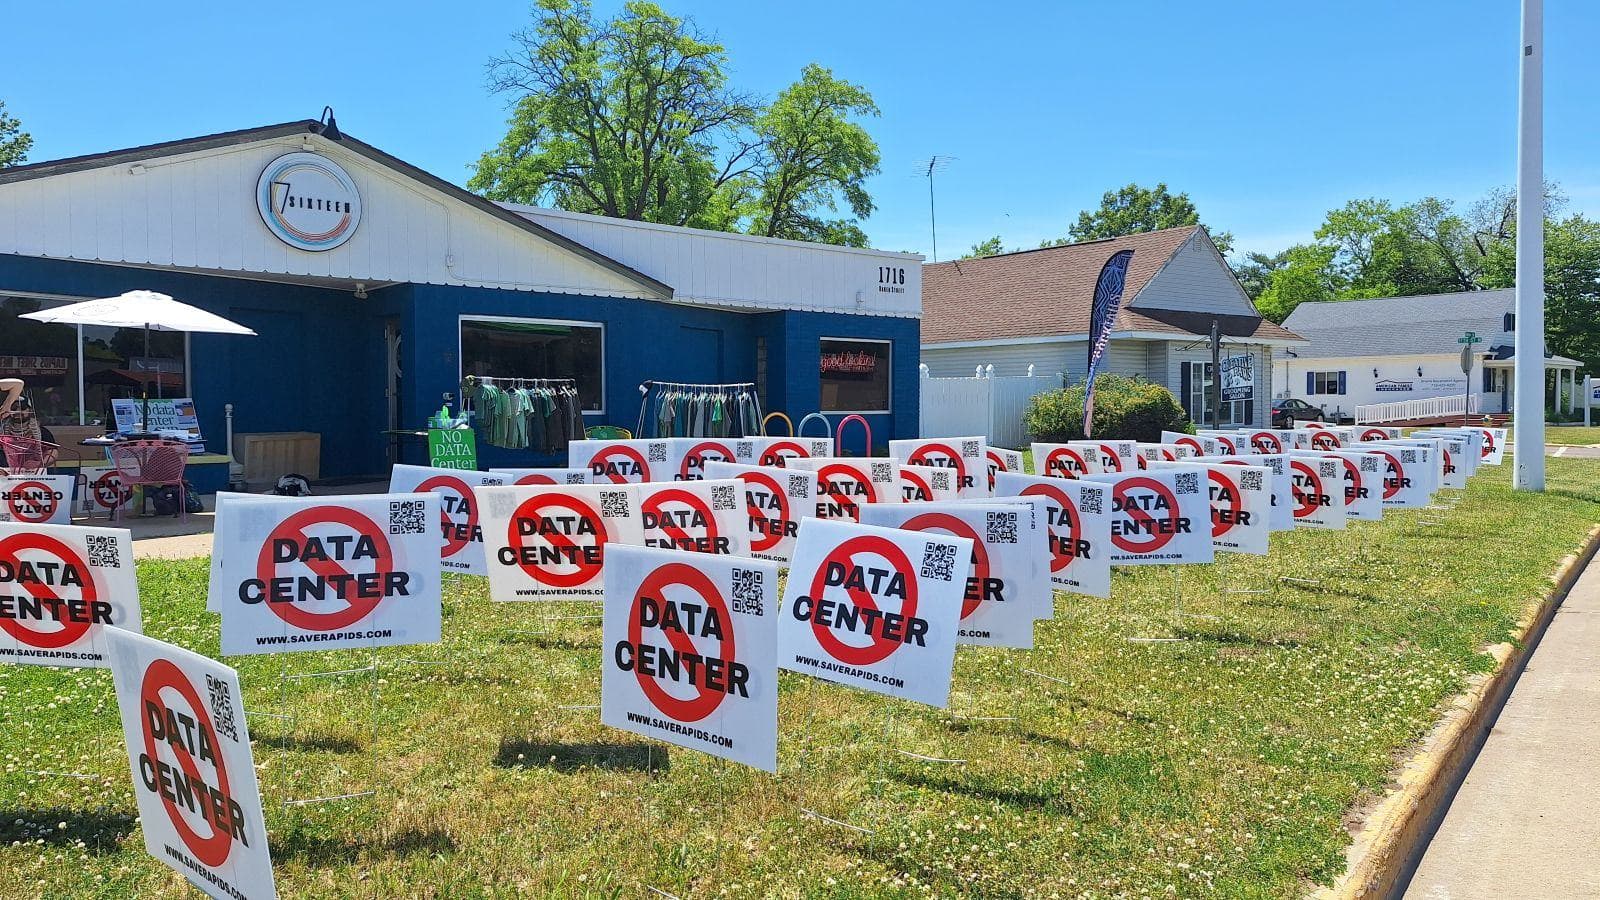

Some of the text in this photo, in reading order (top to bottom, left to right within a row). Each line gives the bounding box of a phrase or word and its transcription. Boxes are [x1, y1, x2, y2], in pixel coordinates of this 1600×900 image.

[289, 196, 350, 213] SIXTEEN
[879, 266, 905, 285] 1716
[1233, 366, 1253, 382] PAWS
[1229, 392, 1246, 400] SALON
[153, 404, 175, 415] data
[441, 430, 462, 443] NO
[1251, 440, 1279, 450] DATA
[1312, 438, 1337, 447] DATA
[435, 443, 472, 456] DATA
[1220, 446, 1233, 455] TA
[431, 456, 476, 469] Center
[592, 461, 644, 476] DATA
[1049, 459, 1082, 471] DATA
[1102, 456, 1118, 467] TA
[89, 480, 121, 489] NTER
[816, 480, 868, 496] DATA
[1292, 474, 1316, 488] TA
[1, 491, 63, 501] CENTER
[745, 490, 782, 511] ATA
[901, 486, 927, 501] TA
[1208, 486, 1232, 502] TA
[1293, 492, 1331, 507] TER
[14, 505, 52, 514] DATA
[441, 496, 471, 514] TA
[816, 502, 859, 518] ENT
[1112, 495, 1171, 513] DATA
[643, 510, 708, 530] DATA
[1046, 506, 1073, 528] TA
[1211, 508, 1251, 526] TER
[441, 522, 484, 543] TER
[516, 516, 597, 536] DATA
[749, 516, 798, 538] TER
[1111, 517, 1192, 536] ENTER
[273, 534, 380, 564] DATA
[645, 536, 731, 555] ENTER
[1048, 534, 1091, 560] TER
[497, 545, 604, 566] CENTE
[751, 552, 788, 563] APIDS.COM
[1111, 553, 1182, 561] W.SAVERAPIDS.COM
[0, 560, 84, 588] DATA
[824, 561, 908, 600] DATA
[238, 571, 410, 605] CENTER
[0, 595, 114, 625] ENTER
[639, 596, 725, 641] DATA
[792, 595, 929, 648] CENTER
[256, 630, 392, 645] WWW.SAVERAPIDS.COM
[0, 648, 103, 661] WW.SAVERAPIDS.COM
[614, 640, 750, 699] CENTER
[795, 654, 904, 689] WWW.SAVERAPIDS.COM
[145, 699, 217, 767] DATA
[627, 711, 733, 749] WWW.SAVERAPIDS.COM
[139, 753, 249, 848] CENTER
